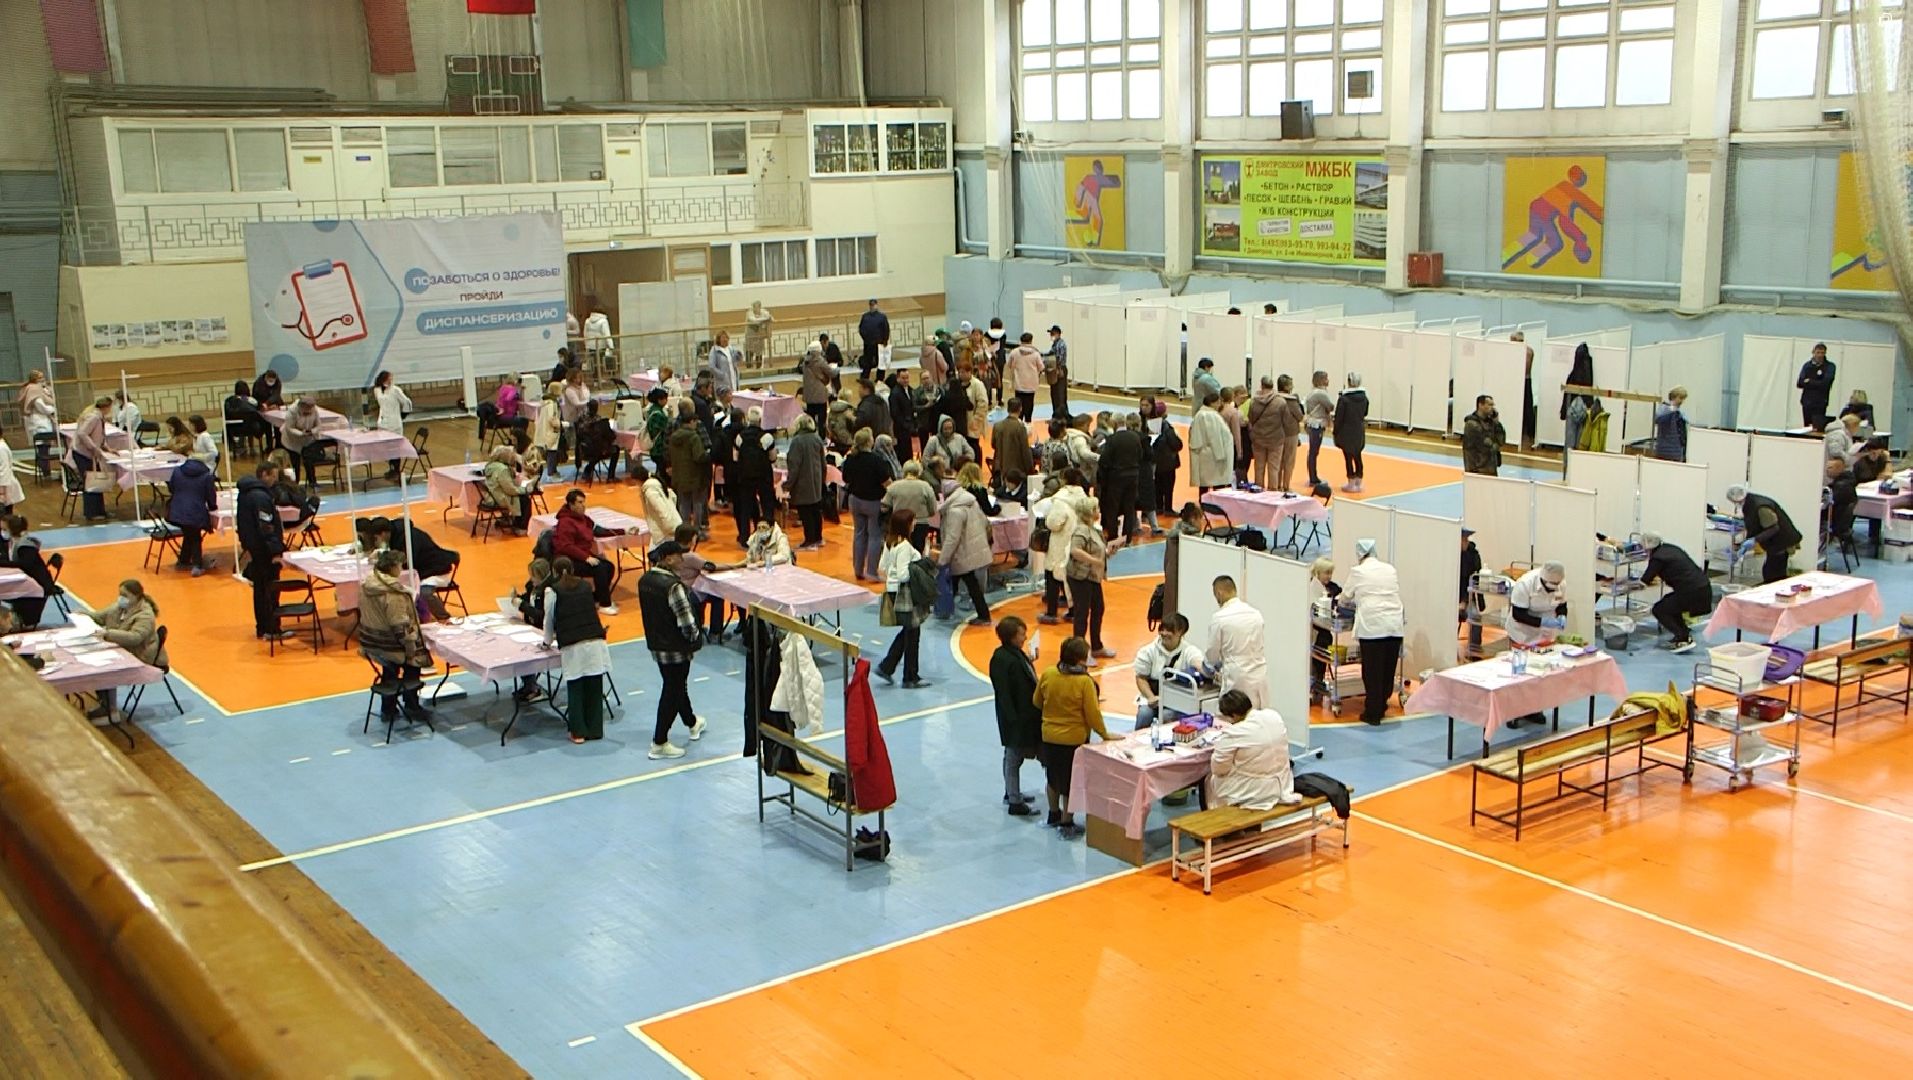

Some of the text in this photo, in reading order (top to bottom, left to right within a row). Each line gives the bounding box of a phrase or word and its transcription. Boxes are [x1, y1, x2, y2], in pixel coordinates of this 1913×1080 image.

[1305, 161, 1351, 177] МЖБК
[1296, 183, 1334, 191] РАСТВОР
[412, 267, 561, 287] ПОЗАБОТЬСЯ О ЗДОРОВЬЕ!
[460, 289, 504, 302] ПРОЙДИ
[424, 307, 559, 331] ДИСПАНСЕРИЗАЦИЮ
